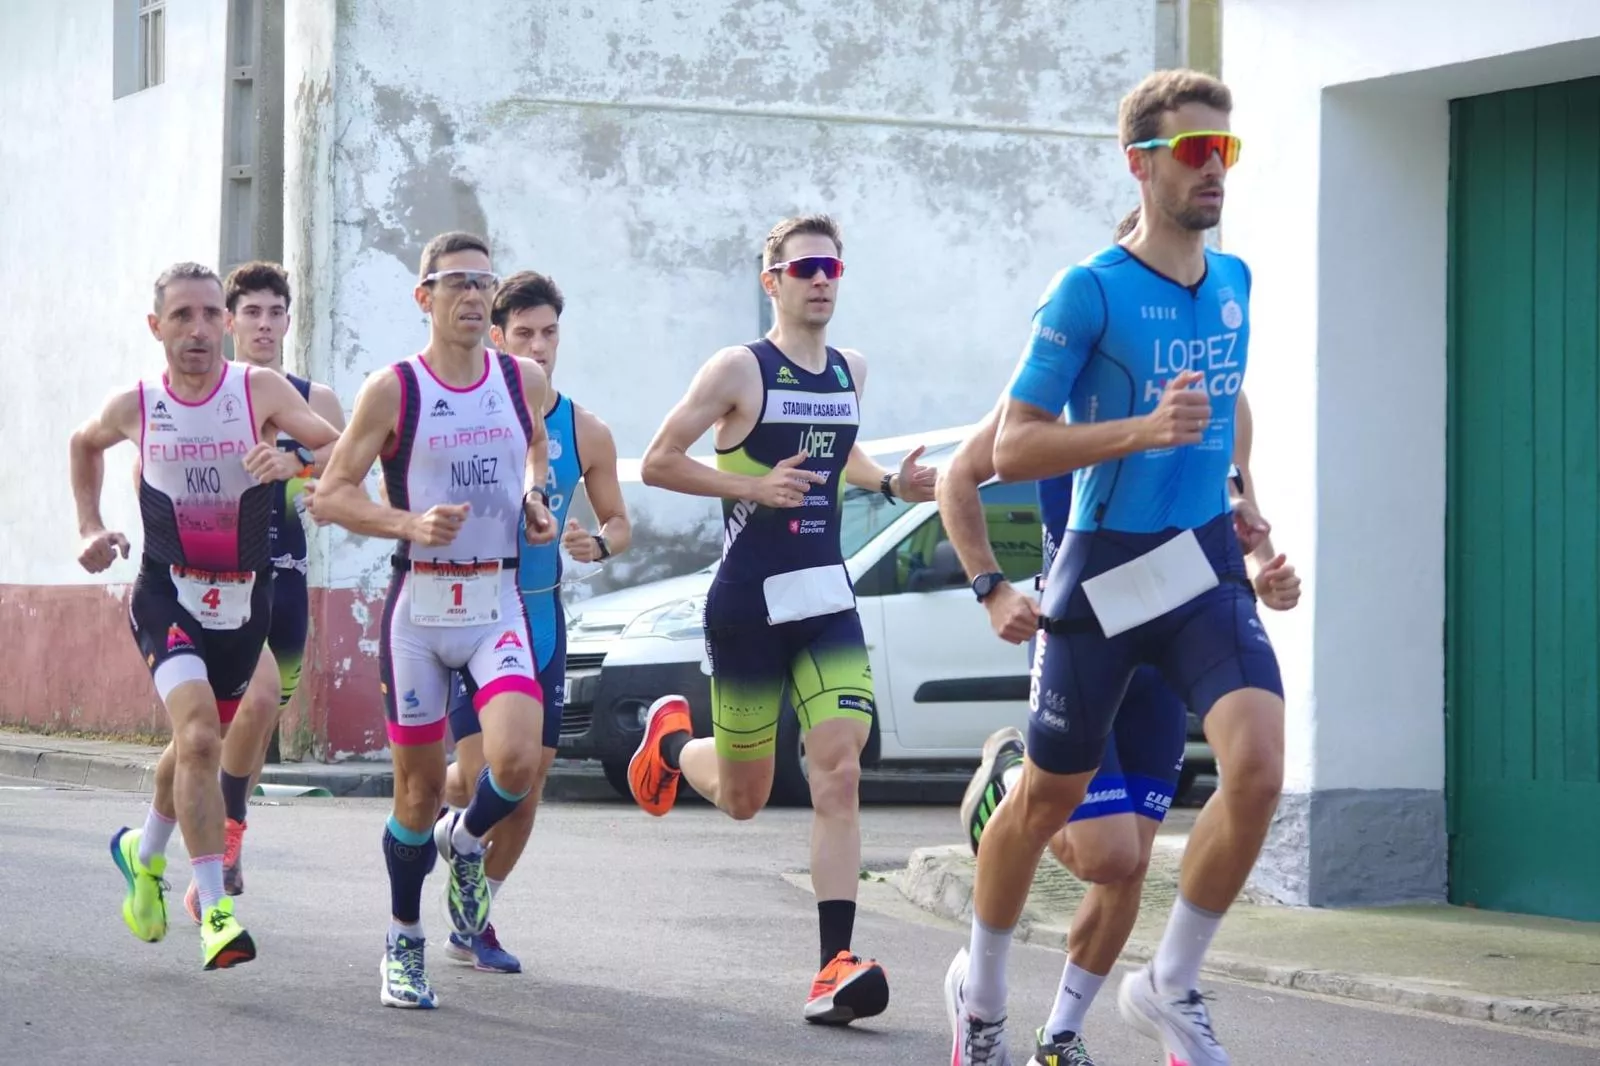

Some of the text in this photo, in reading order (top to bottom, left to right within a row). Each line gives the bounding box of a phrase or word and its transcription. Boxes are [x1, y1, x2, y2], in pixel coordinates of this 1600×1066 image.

[1153, 332, 1238, 375] LOPEZ
[782, 401, 851, 417] STADIUM CASABLANCA
[149, 440, 248, 462] EUROPA
[428, 426, 514, 451] EUROPA
[799, 425, 836, 458] LÓPEZ
[185, 466, 221, 494] KIKO
[451, 454, 499, 487] NUÑEZ
[202, 588, 221, 610] 4
[451, 583, 463, 606] 1
